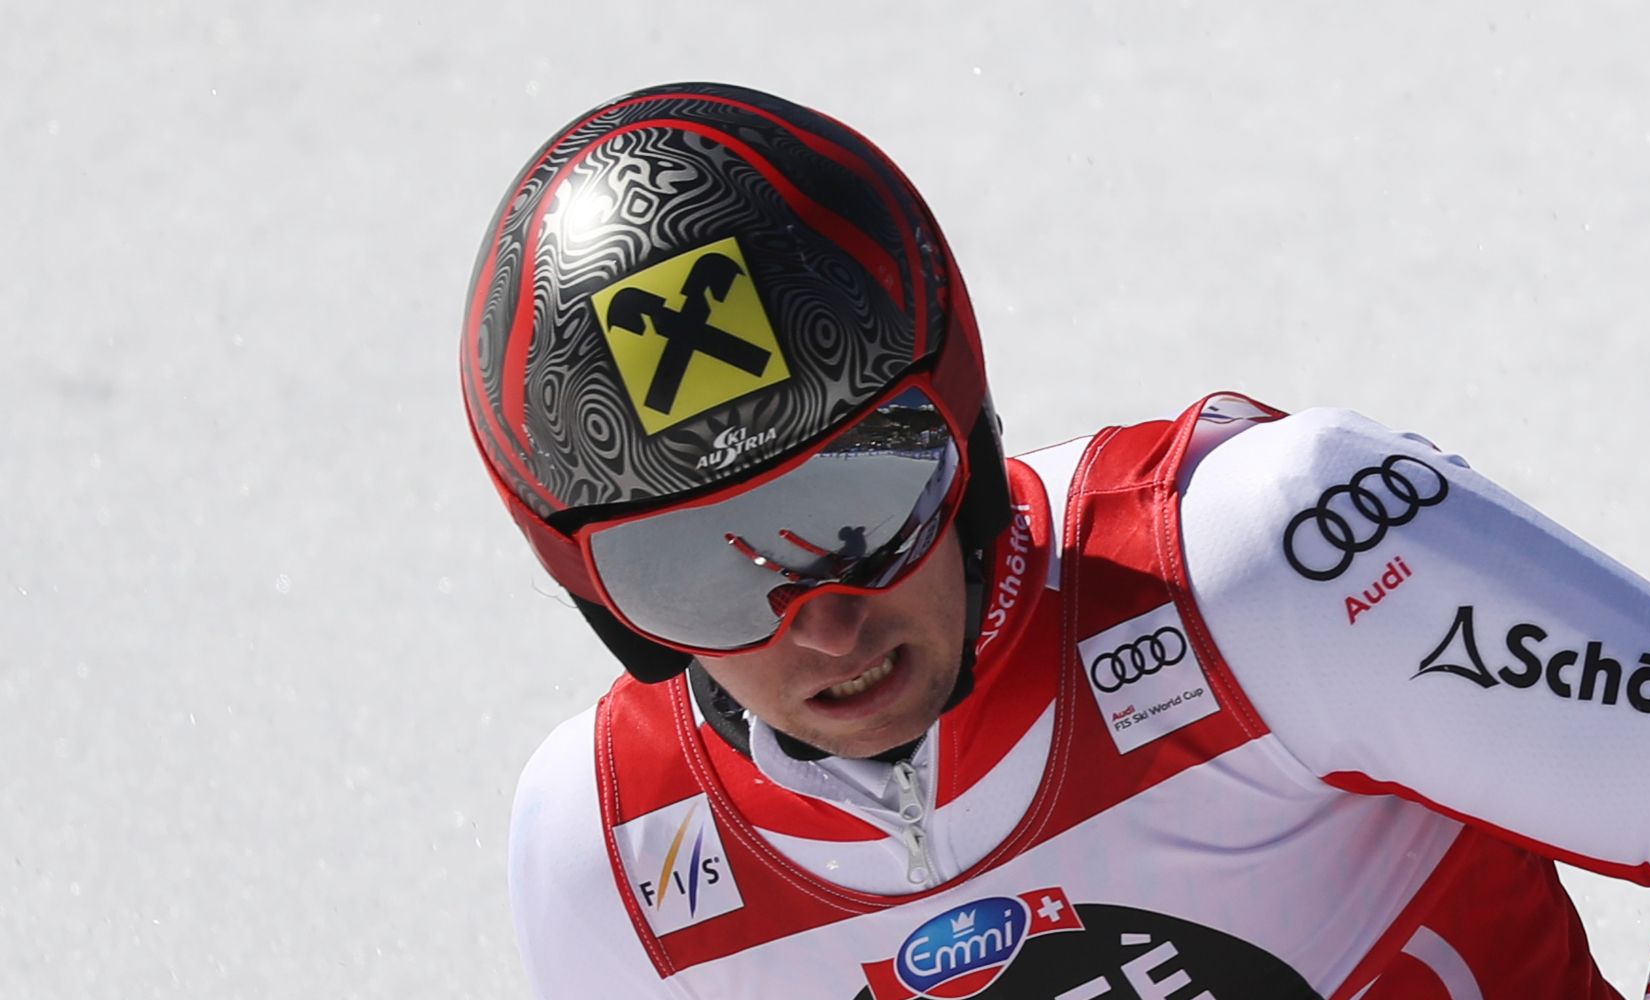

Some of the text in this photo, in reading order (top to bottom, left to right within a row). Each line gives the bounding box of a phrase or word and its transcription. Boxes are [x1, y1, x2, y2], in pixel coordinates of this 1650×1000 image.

[695, 427, 777, 470] AUSTRIA
[1342, 555, 1414, 625] Audi
[1112, 705, 1136, 722] Audi
[1114, 688, 1204, 731] FIS Ski World Cup
[639, 856, 720, 906] FIS
[904, 909, 1014, 976] Emmi
